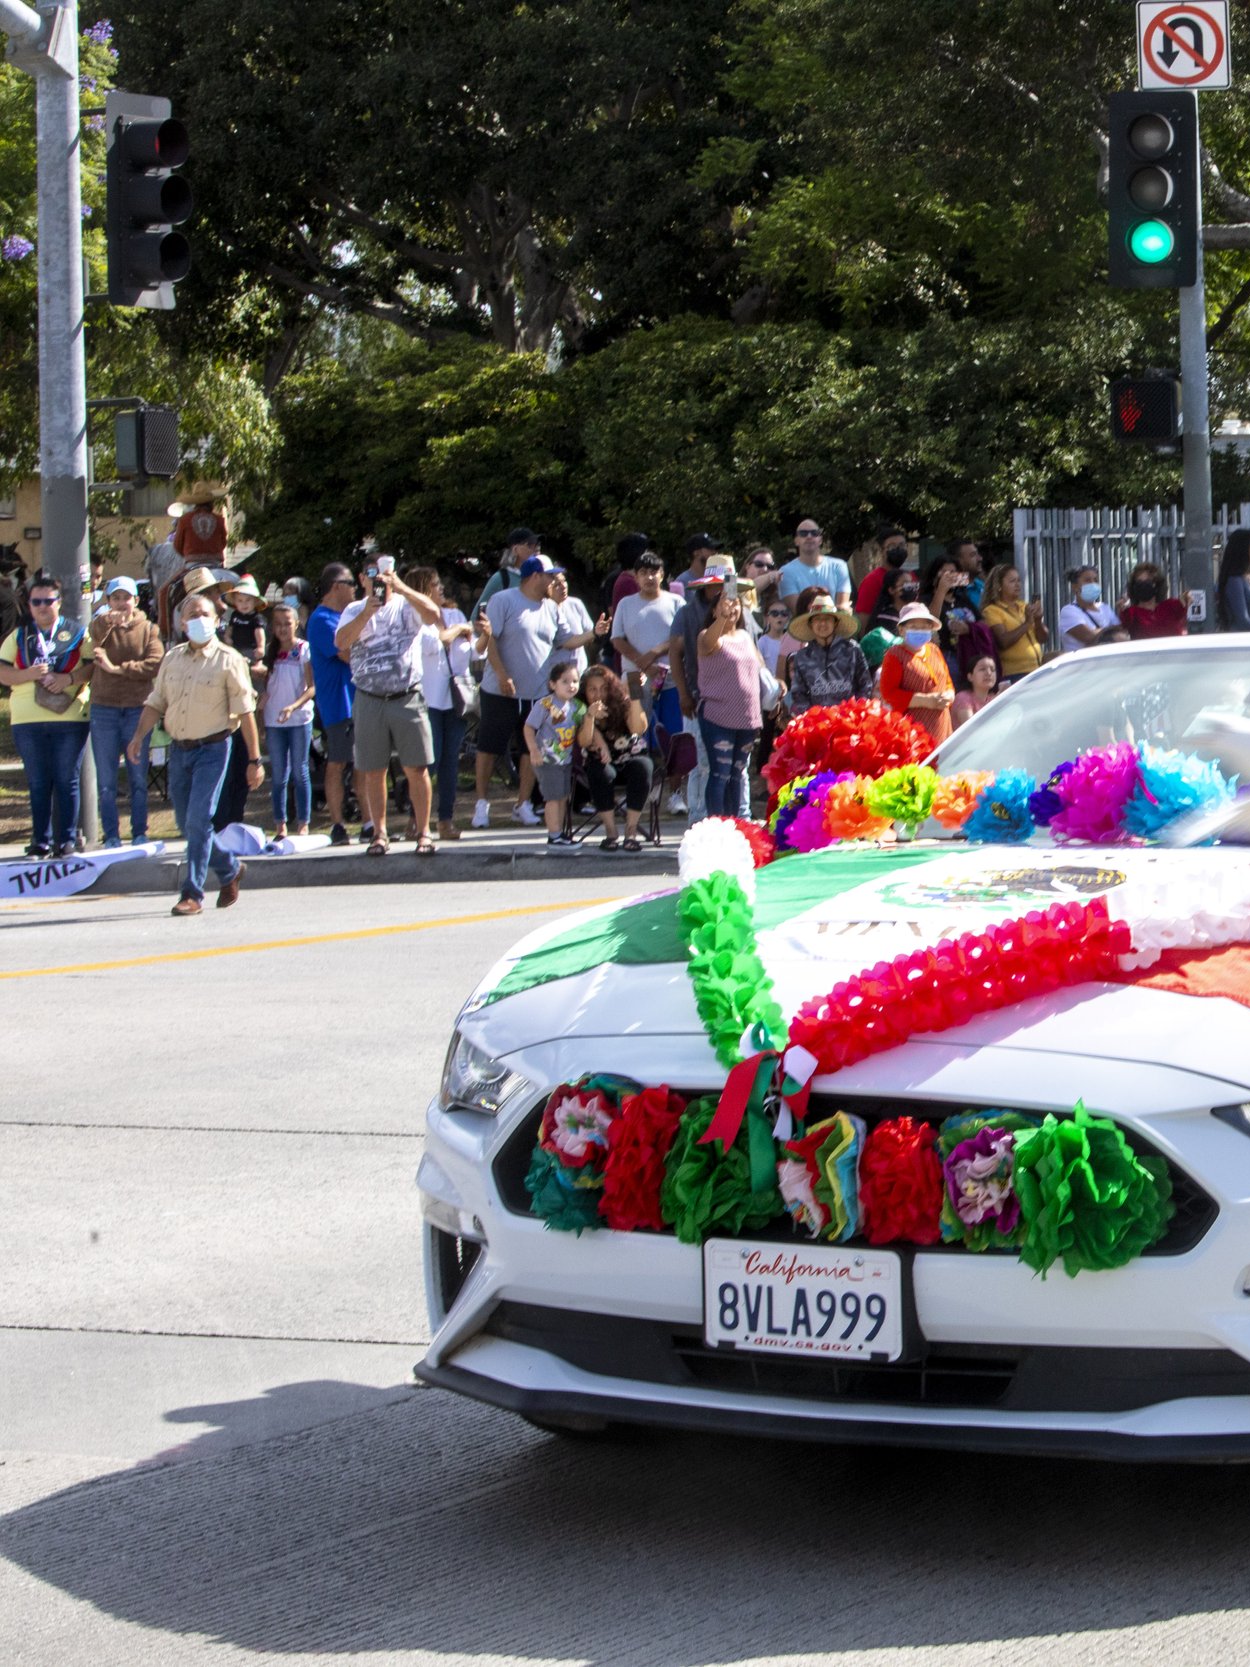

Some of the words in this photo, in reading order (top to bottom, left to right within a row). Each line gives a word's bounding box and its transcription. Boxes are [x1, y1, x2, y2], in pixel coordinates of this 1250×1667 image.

[745, 1250, 864, 1285] California
[718, 1281, 887, 1343] 8VLA999
[753, 1335, 853, 1352] dmv.ca.gov
